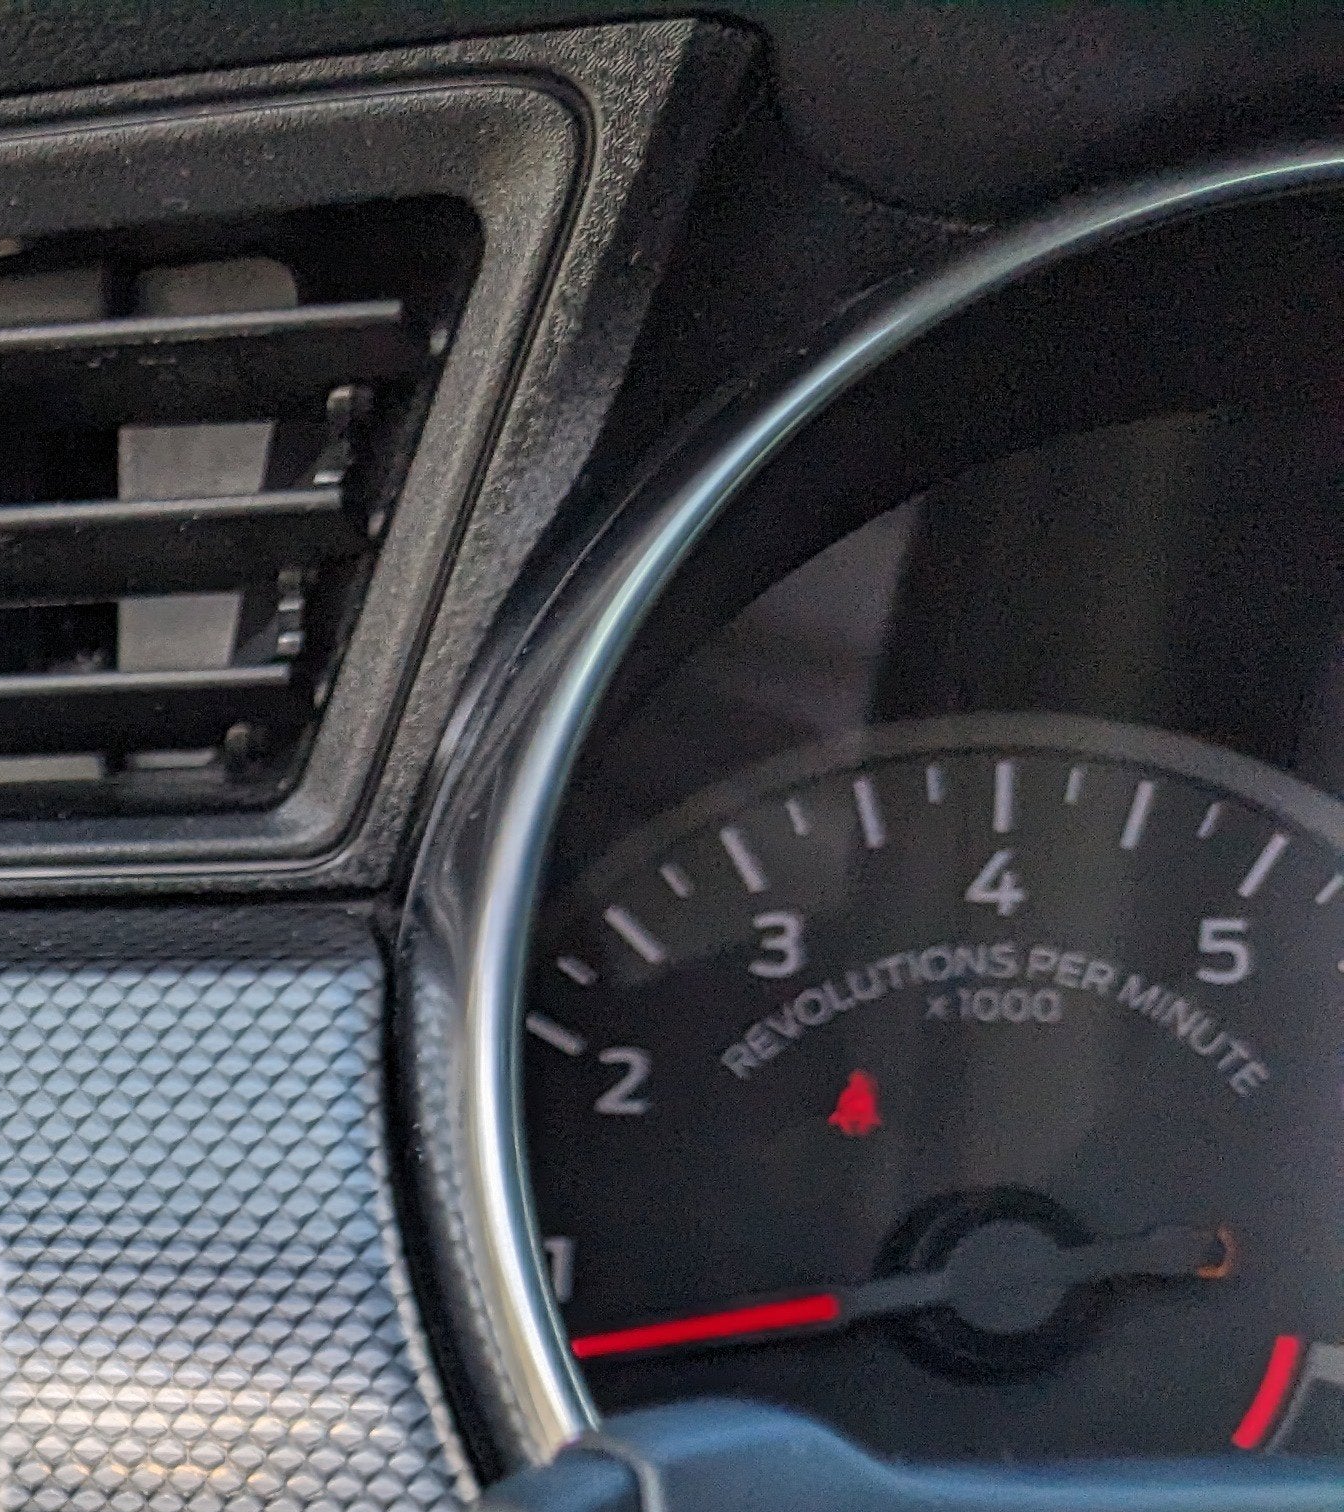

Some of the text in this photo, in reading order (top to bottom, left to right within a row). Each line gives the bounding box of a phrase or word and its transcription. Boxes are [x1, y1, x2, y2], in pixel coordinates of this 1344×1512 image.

[965, 849, 1026, 917] 4
[748, 912, 806, 978] 3
[1196, 918, 1252, 985] 5
[720, 942, 1269, 1099] REVOLUTIONS PER MINUTE
[593, 1047, 651, 1116] 2
[543, 1237, 572, 1302] 1
